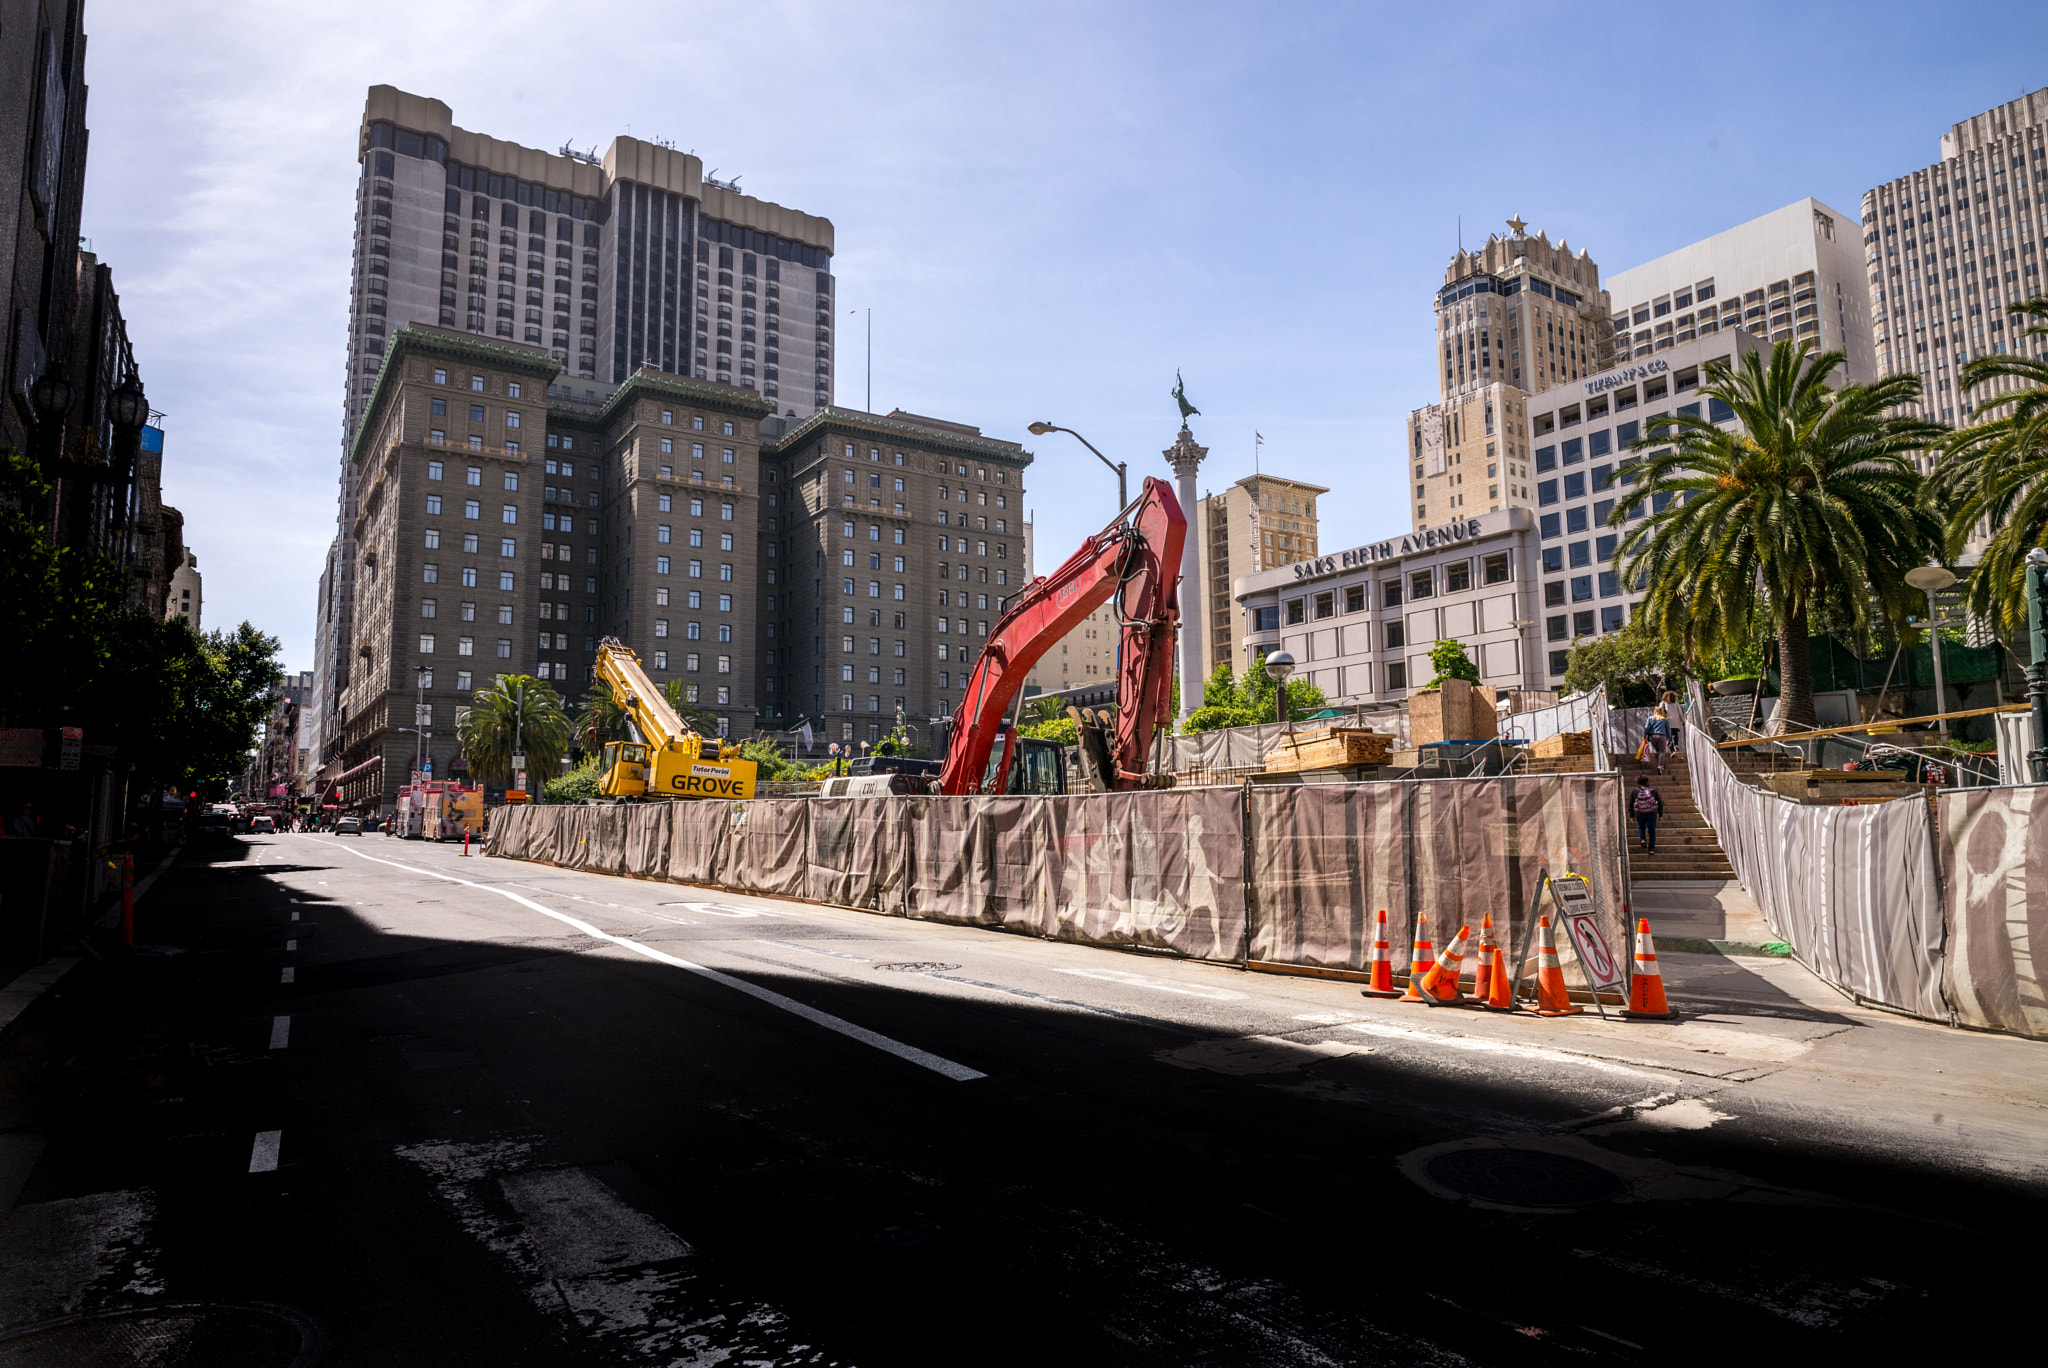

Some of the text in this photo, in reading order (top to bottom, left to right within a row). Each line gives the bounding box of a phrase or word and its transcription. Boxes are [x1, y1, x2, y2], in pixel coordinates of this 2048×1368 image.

[1584, 367, 1634, 392] TIFFANY
[1294, 519, 1478, 579] SAKS FIFTH AVENUE
[1060, 578, 1077, 602] EBI
[424, 764, 431, 772] P
[672, 775, 743, 796] GROVE
[862, 783, 876, 795] EBI
